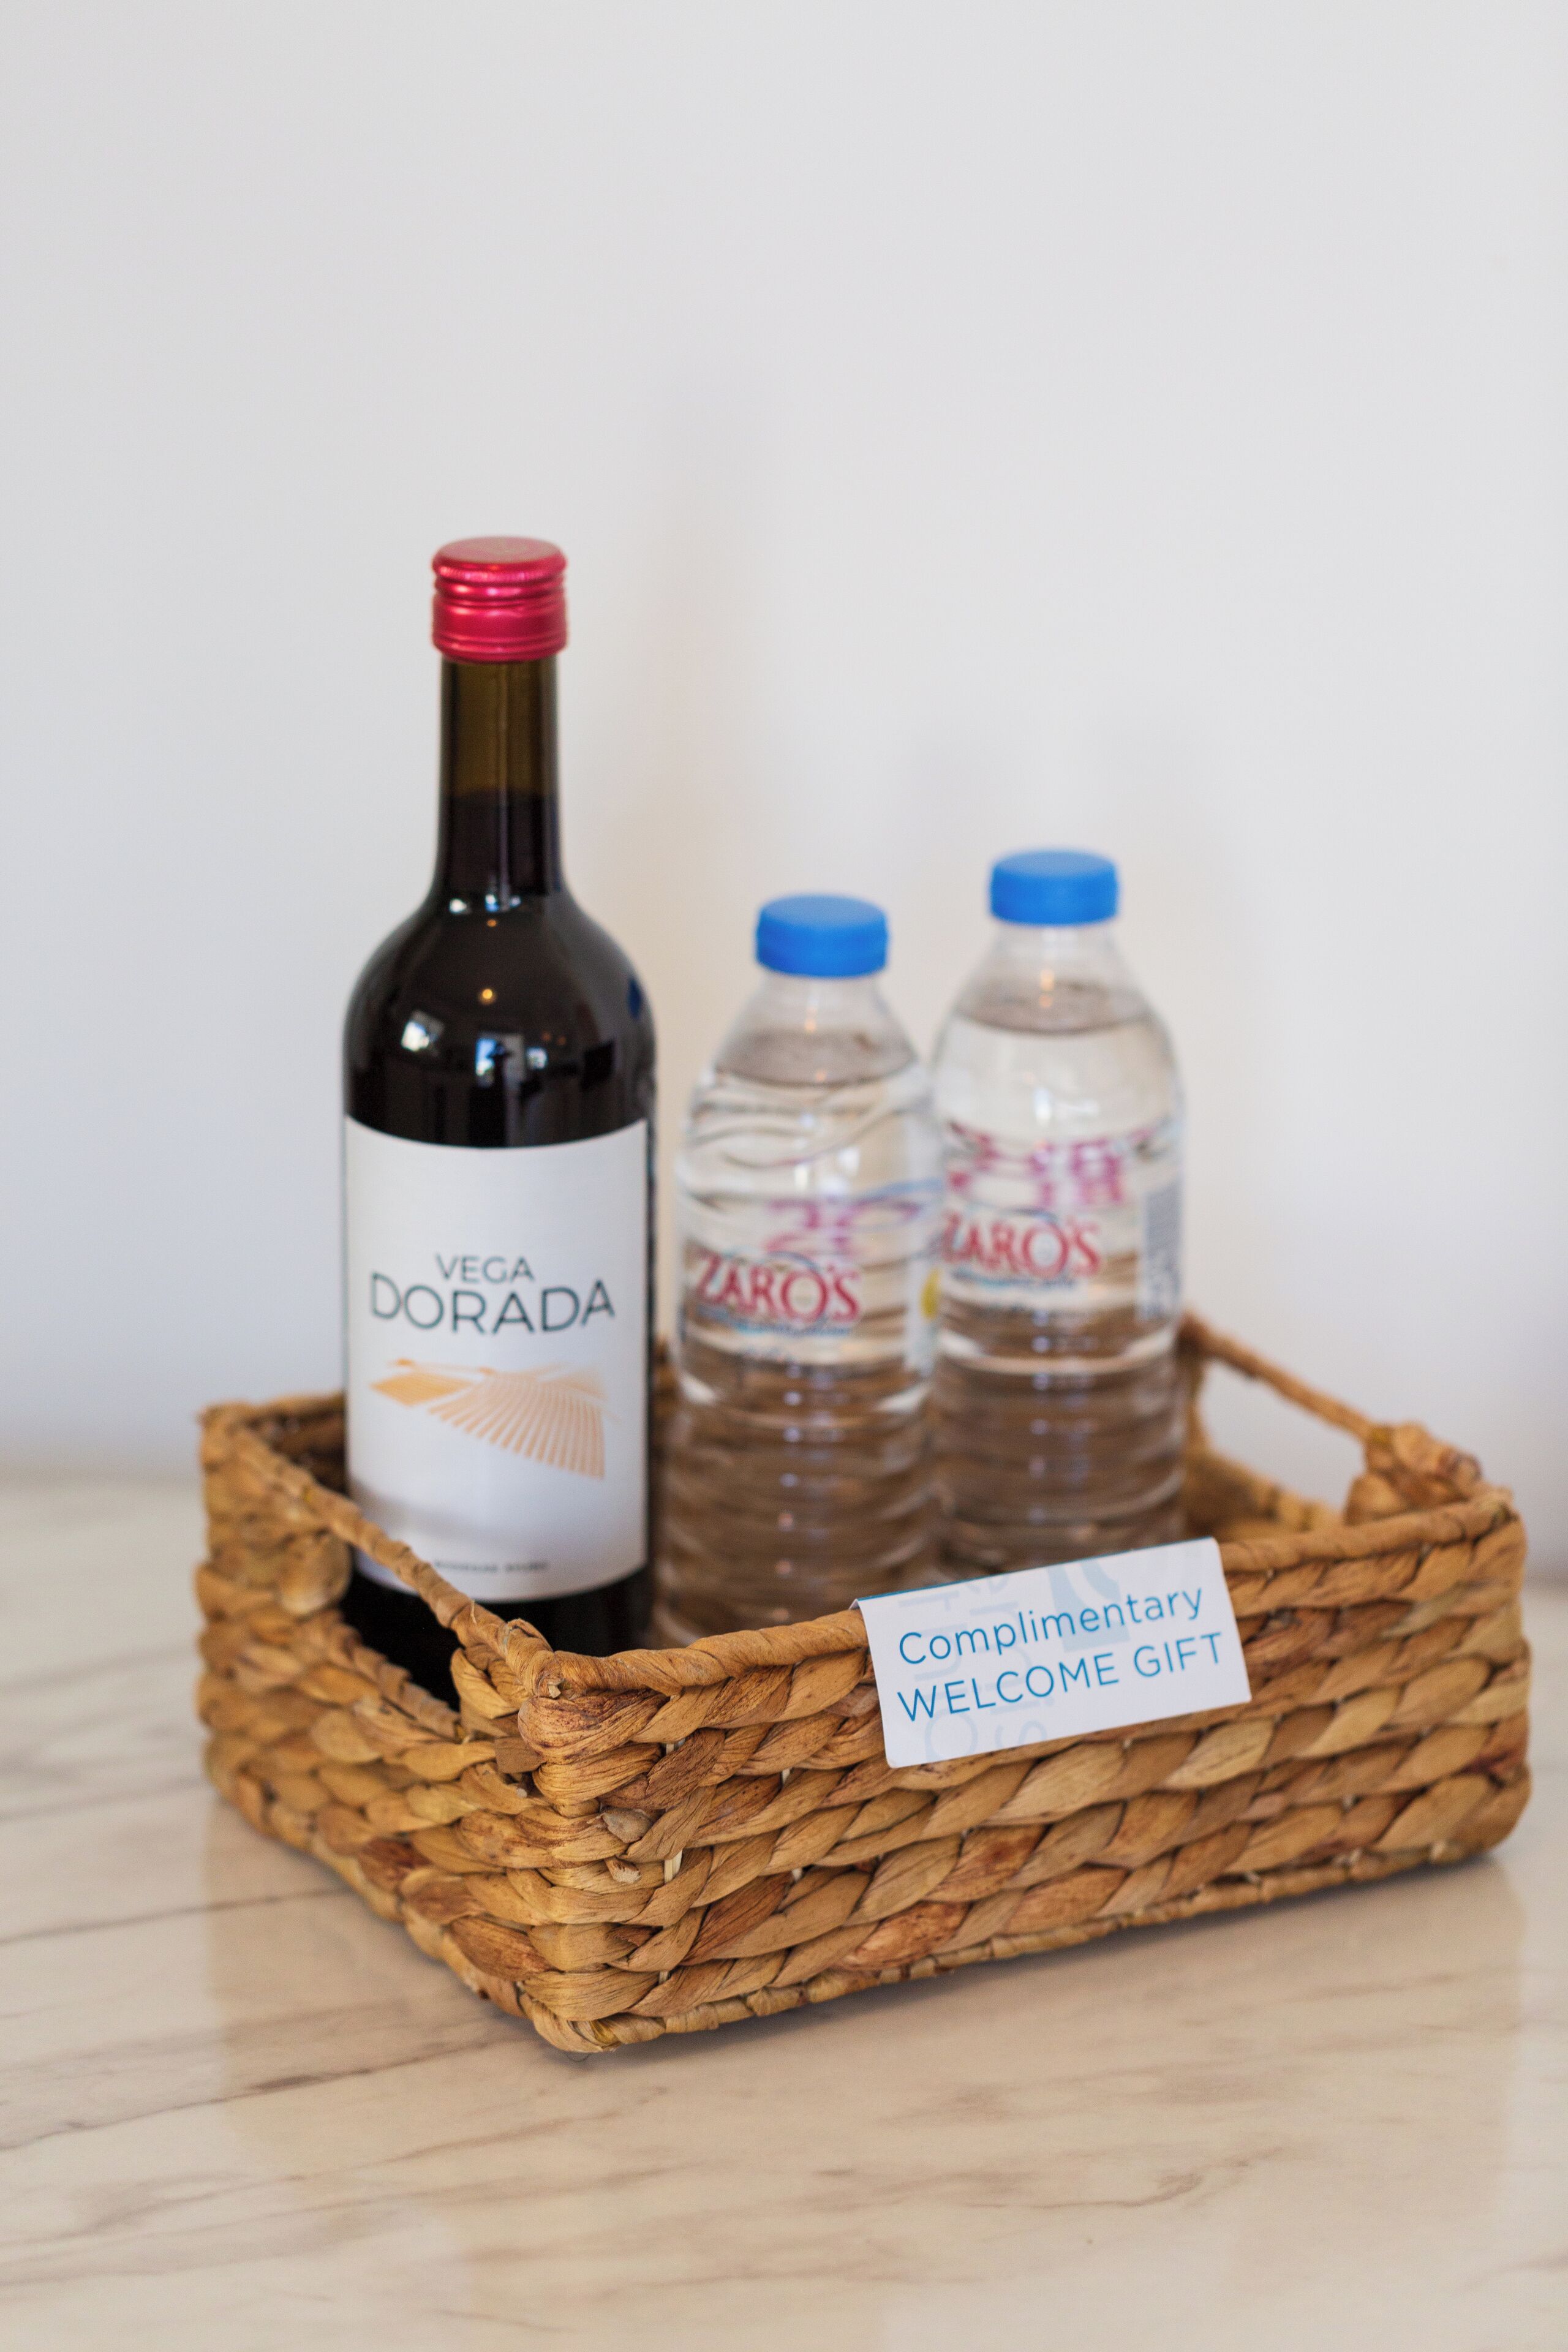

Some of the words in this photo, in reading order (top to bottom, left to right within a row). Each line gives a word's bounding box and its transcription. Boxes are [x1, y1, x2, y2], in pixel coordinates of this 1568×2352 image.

[371, 1272, 616, 1334] DORADA
[435, 1253, 535, 1284] VEGA
[695, 1248, 860, 1323] ZARO'S
[899, 1588, 1202, 1665] Complimentary
[897, 1652, 1120, 1722] WELCOME
[1133, 1632, 1223, 1678] GIFT
